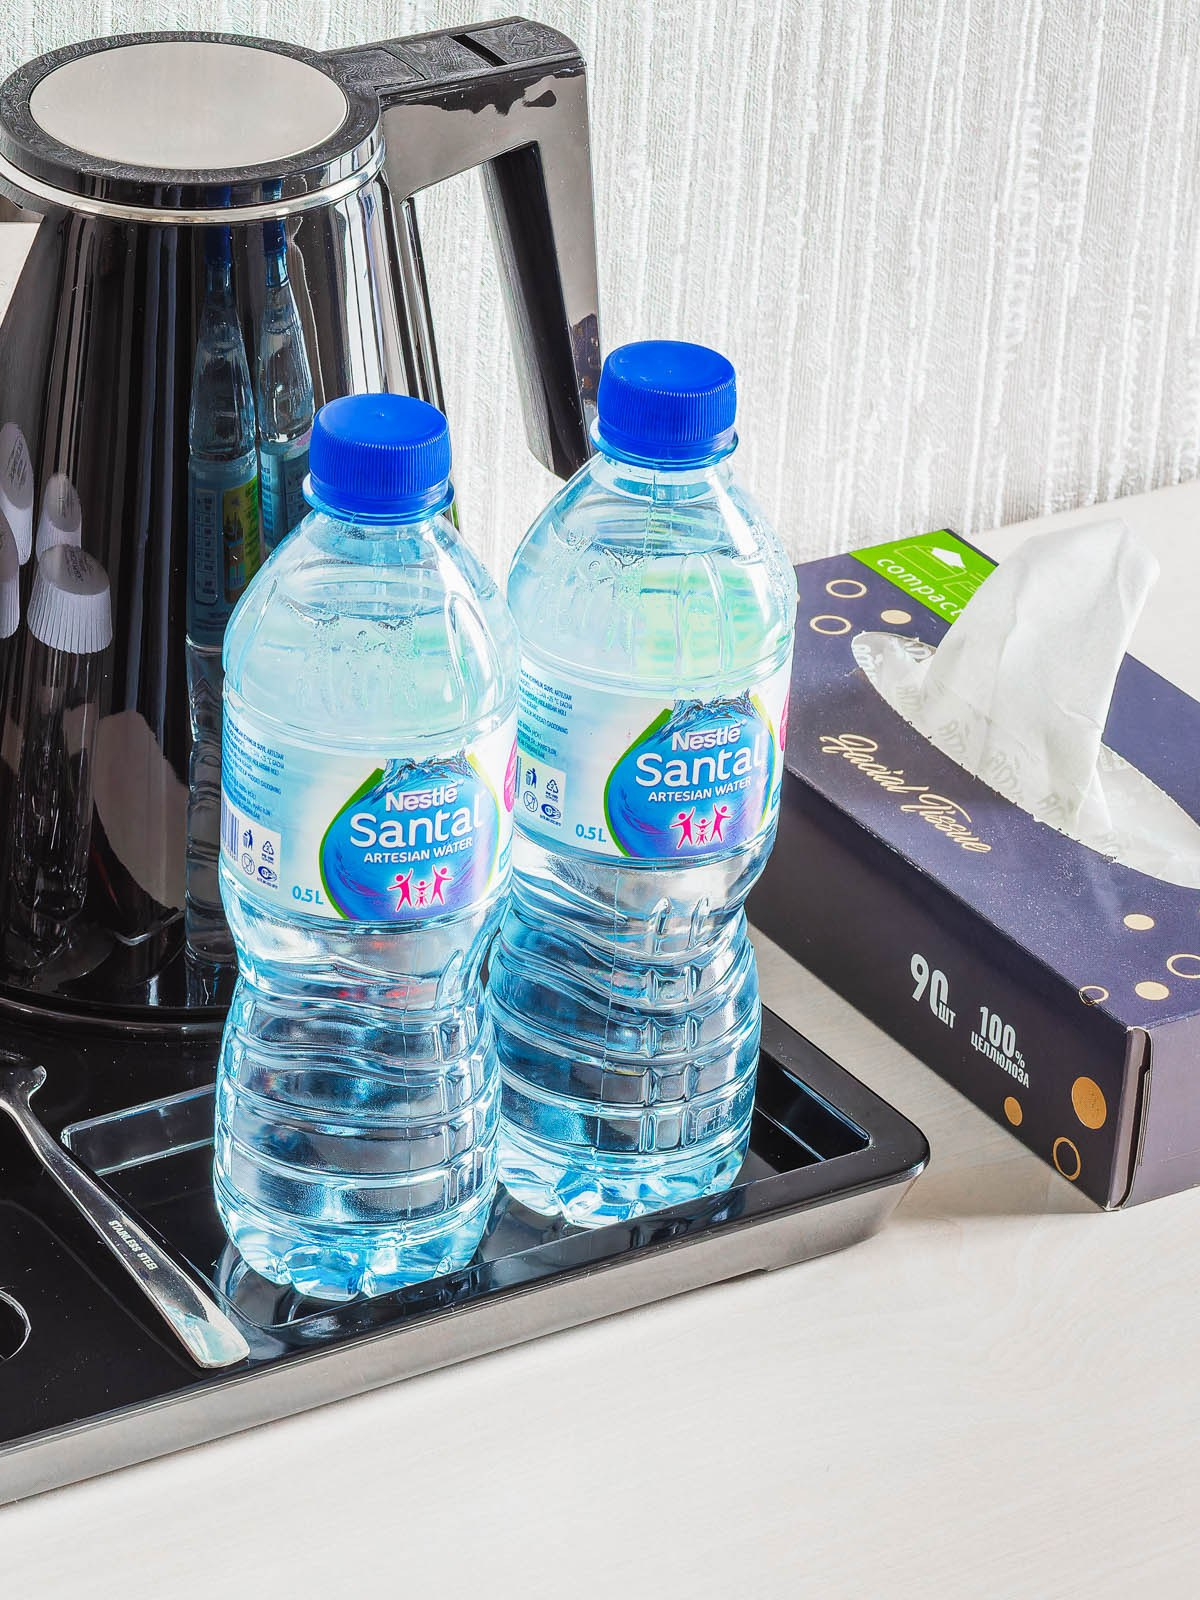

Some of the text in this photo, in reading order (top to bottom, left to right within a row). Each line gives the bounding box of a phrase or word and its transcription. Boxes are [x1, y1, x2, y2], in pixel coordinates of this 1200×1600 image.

[635, 733, 762, 788] Santal
[648, 776, 751, 802] ARTESIAN WATER
[819, 733, 930, 794] Facial
[900, 794, 992, 853] Tissue
[350, 792, 485, 848] Santal
[363, 837, 473, 863] ARTESIAN WATER
[910, 953, 949, 1016] 90
[971, 1031, 1029, 1088] ЦЕЛЛЮЛОЗА
